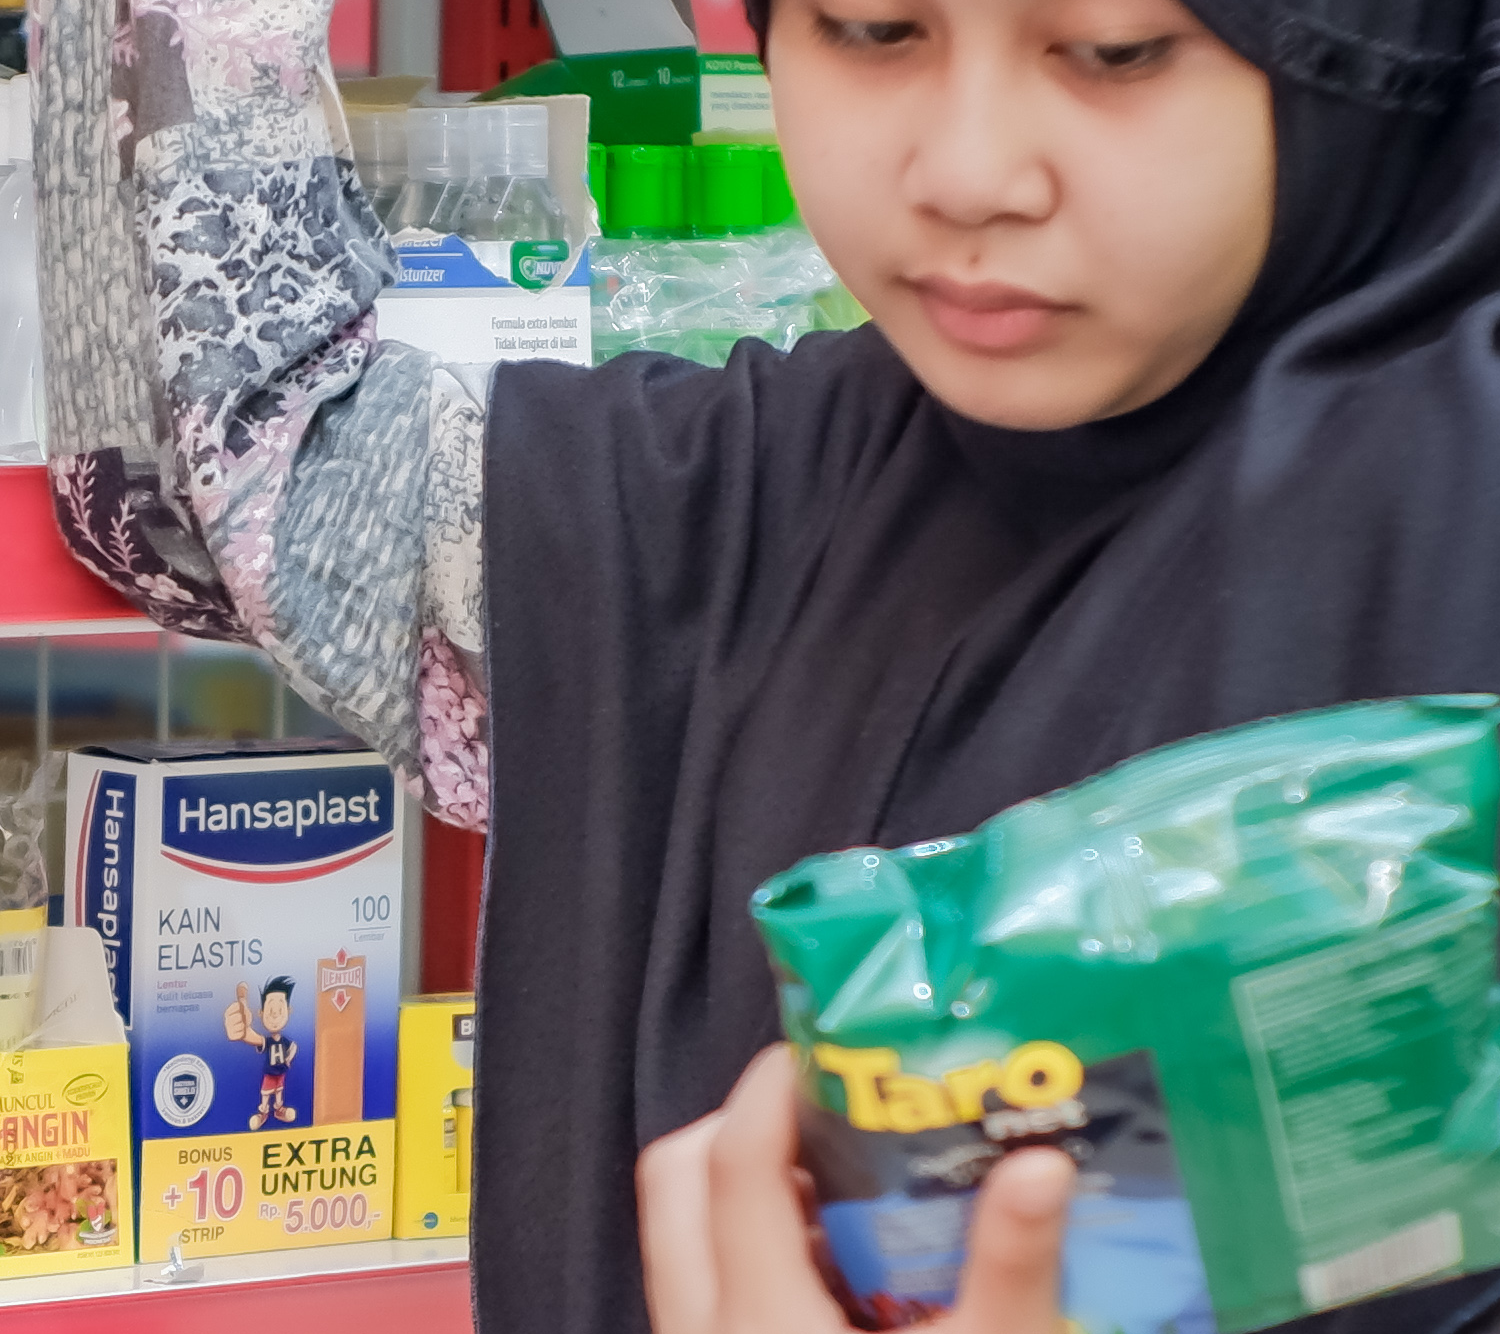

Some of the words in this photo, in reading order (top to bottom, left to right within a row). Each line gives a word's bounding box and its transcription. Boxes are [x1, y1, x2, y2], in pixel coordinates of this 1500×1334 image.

[491, 317, 525, 329] Formula
[527, 320, 547, 329] extra
[494, 337, 516, 349] Tidak
[518, 336, 548, 351] lengket
[550, 337, 558, 348] di
[178, 788, 380, 837] Hansaplast
[158, 906, 221, 936] KAIN
[350, 895, 390, 922] 100
[157, 939, 263, 971] ELASTIS
[157, 991, 178, 1002] Kulit
[814, 1040, 1085, 1133] Taro
[25, 1150, 53, 1164] ANGIN
[62, 1147, 91, 1160] MADU
[178, 1146, 233, 1165] BONUS
[262, 1134, 377, 1170] EXTRA
[261, 1163, 378, 1197] UNTUNG
[180, 1226, 225, 1244] STRIP
